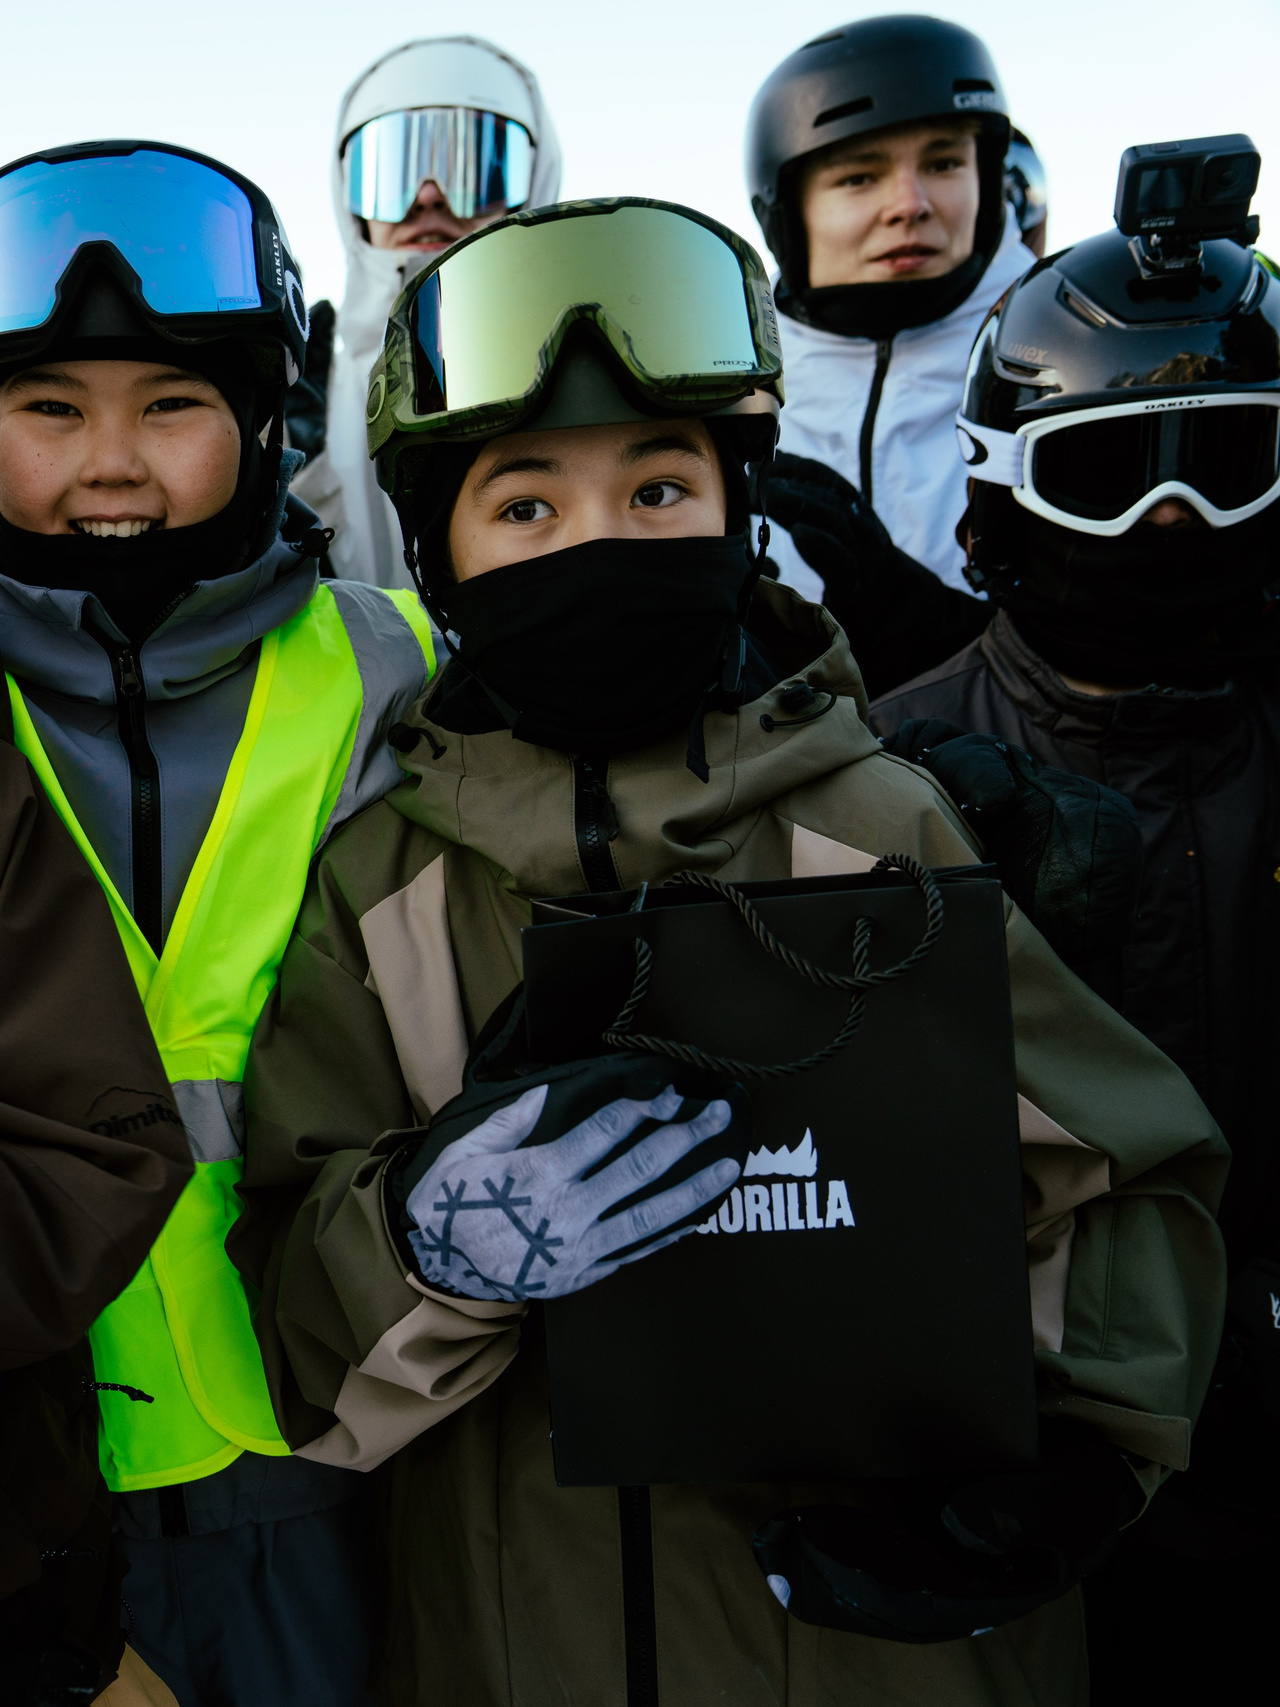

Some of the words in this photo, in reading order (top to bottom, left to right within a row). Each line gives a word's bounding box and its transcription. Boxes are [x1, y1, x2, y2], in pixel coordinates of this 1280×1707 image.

[271, 231, 283, 286] OAKLEY
[765, 289, 779, 346] OAKLEY
[1005, 342, 1049, 365] uvex
[1144, 399, 1206, 411] OAKLEY
